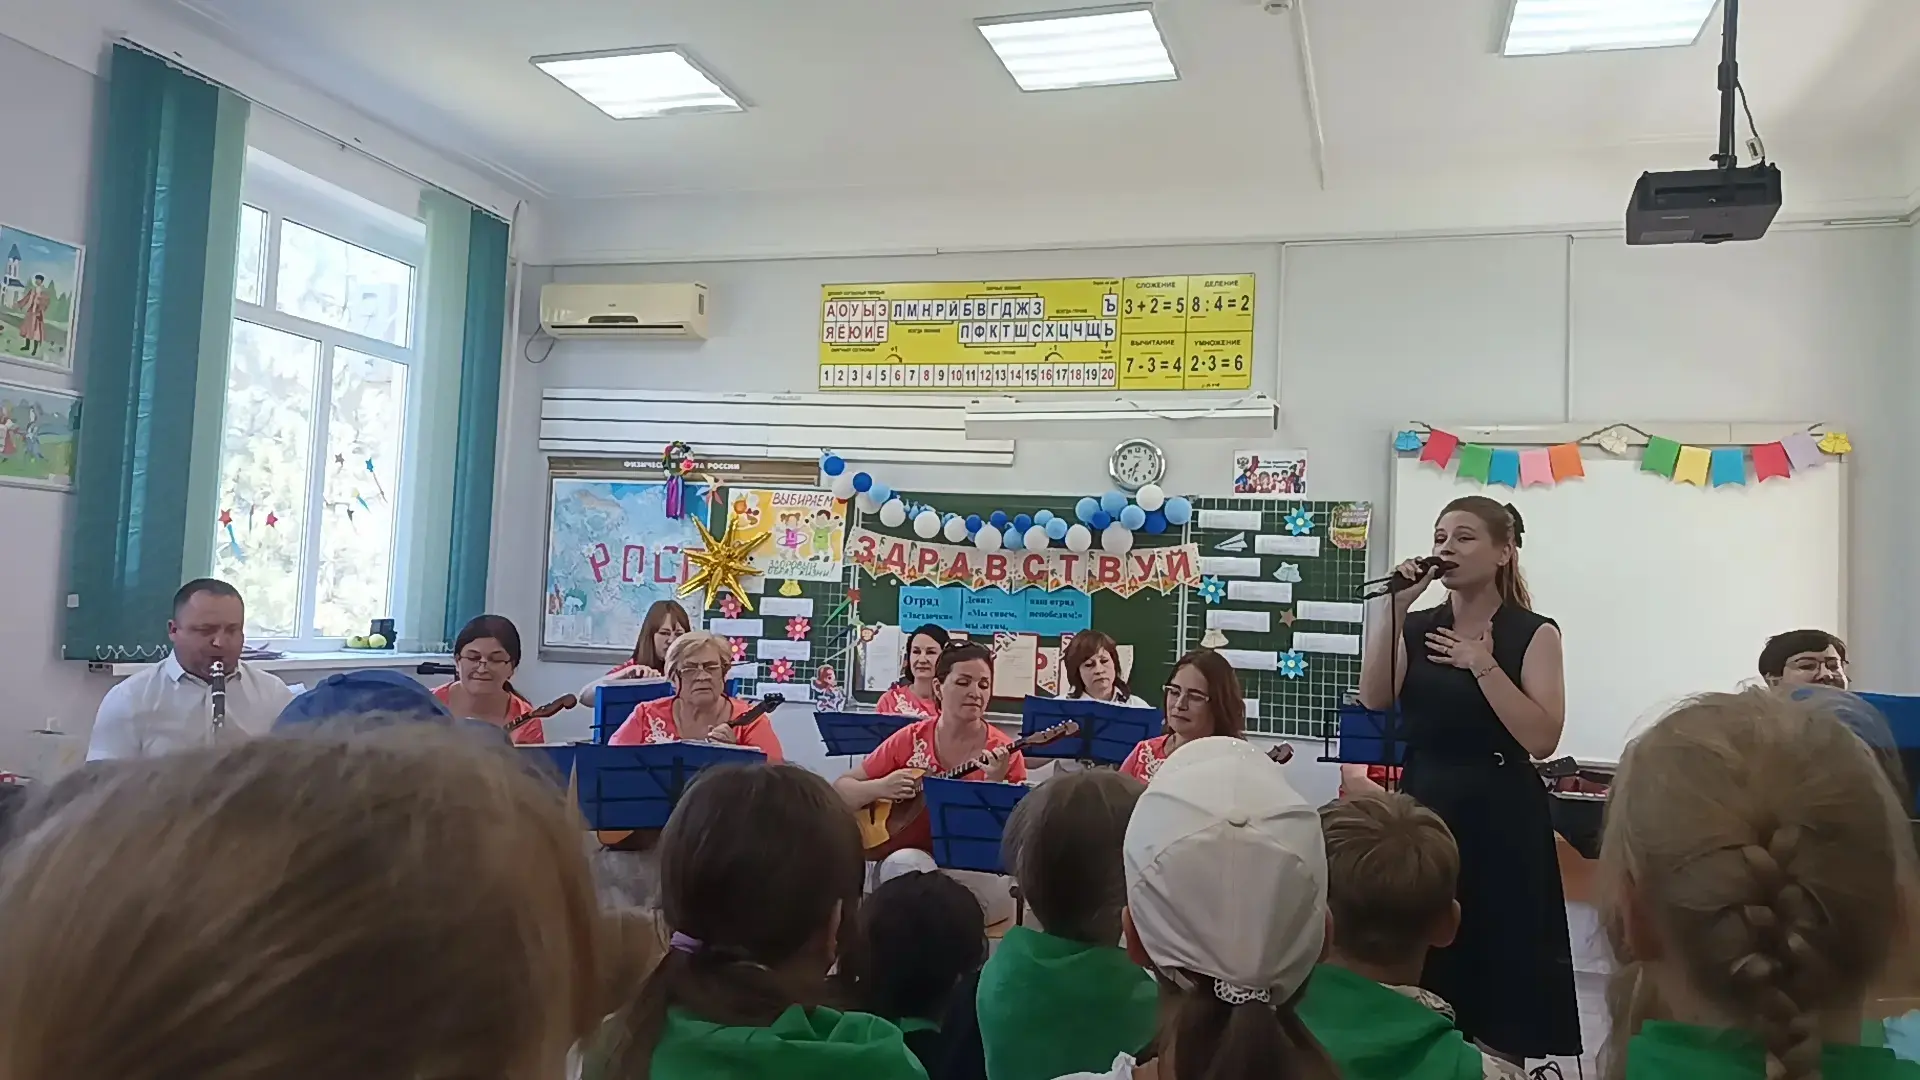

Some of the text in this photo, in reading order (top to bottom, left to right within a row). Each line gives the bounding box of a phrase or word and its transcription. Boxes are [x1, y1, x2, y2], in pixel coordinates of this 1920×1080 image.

[1135, 281, 1176, 289] СЛОЖЕНИЕ
[1204, 280, 1239, 288] ДЕЛЕНИЕ
[1104, 298, 1116, 312] Ъ
[1124, 298, 1133, 314] 3
[1149, 297, 1159, 313] 2
[1175, 297, 1185, 313] 5
[1191, 296, 1200, 312] 8
[1213, 295, 1223, 311] 4
[1240, 294, 1250, 311] 2
[1130, 339, 1175, 347] ВЫЧИТАНИЕ
[1194, 339, 1241, 347] УМНОЖЕНИЕ
[1126, 357, 1134, 373] 7
[1147, 356, 1156, 373] 3
[1172, 356, 1182, 373] 4
[1190, 355, 1199, 371] 2
[1208, 354, 1217, 371] 3
[1234, 354, 1243, 371] 6
[824, 369, 1114, 381] 1 2 3 4 5 6 7 8 9 10 11 12 13 14 15 16 17 18 19 20
[707, 462, 741, 470] РОССИИ
[772, 492, 834, 508] ВЫБИРАЕМ
[855, 535, 1192, 583] ЗДРАВСТВУЙ
[903, 595, 940, 608] Отряд
